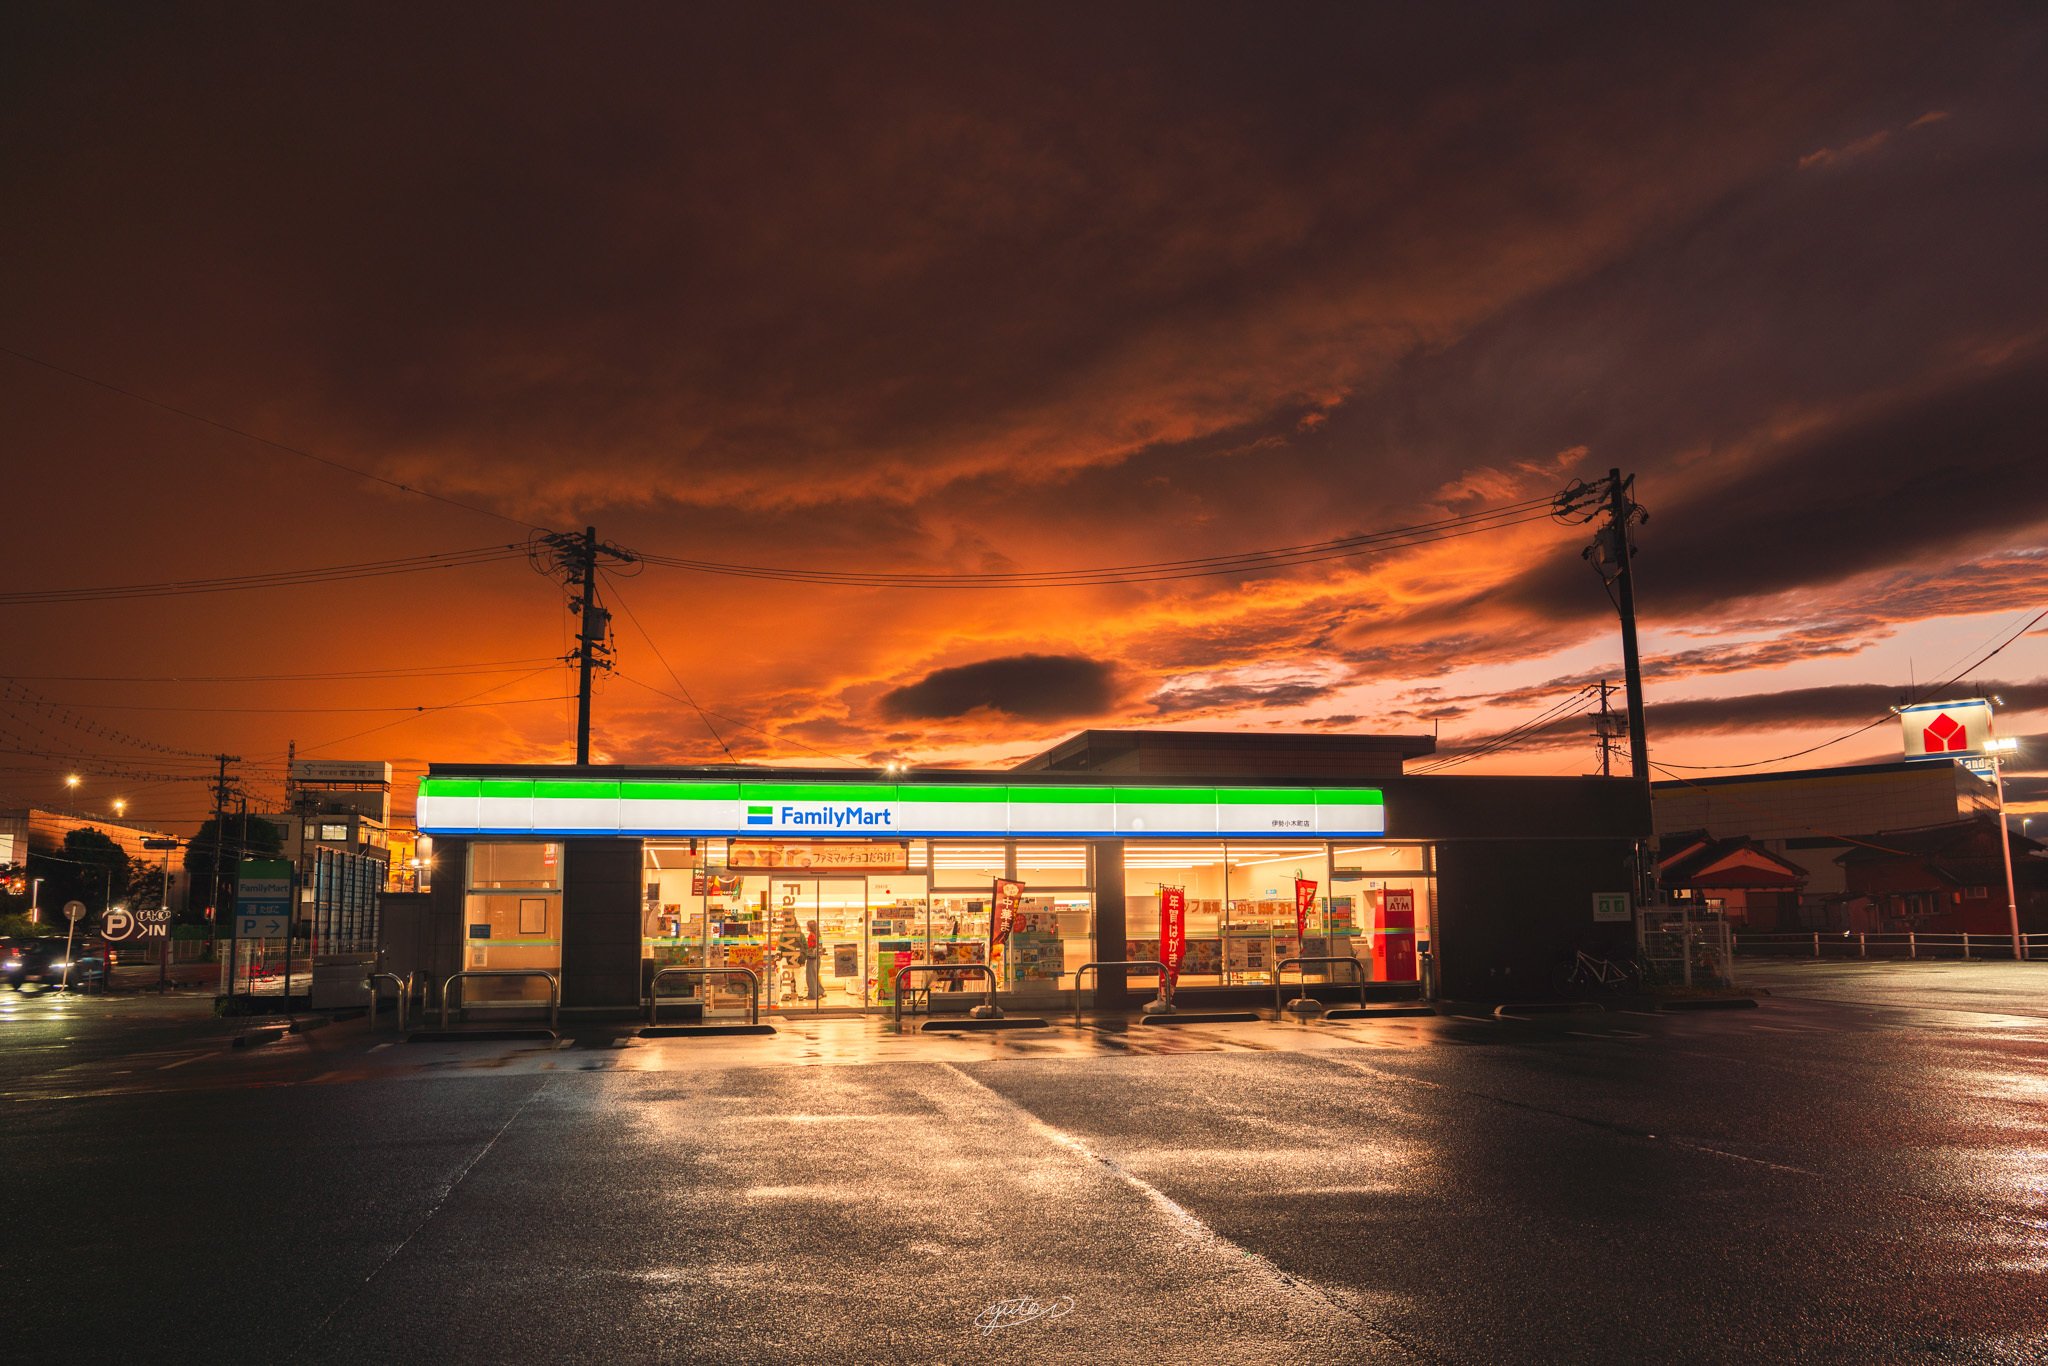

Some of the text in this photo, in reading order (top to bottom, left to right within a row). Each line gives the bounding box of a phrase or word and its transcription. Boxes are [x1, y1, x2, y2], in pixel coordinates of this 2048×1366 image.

[781, 806, 891, 828] FamilyMart
[1271, 819, 1310, 828] 伊勢小木町店
[240, 883, 288, 893] FamilyMart
[1389, 902, 1410, 910] ATM
[107, 915, 127, 934] P
[148, 924, 167, 936] IN
[244, 919, 257, 934] P
[1168, 894, 1180, 967] 年賀はがき
[779, 883, 801, 1001] FamilyMart
